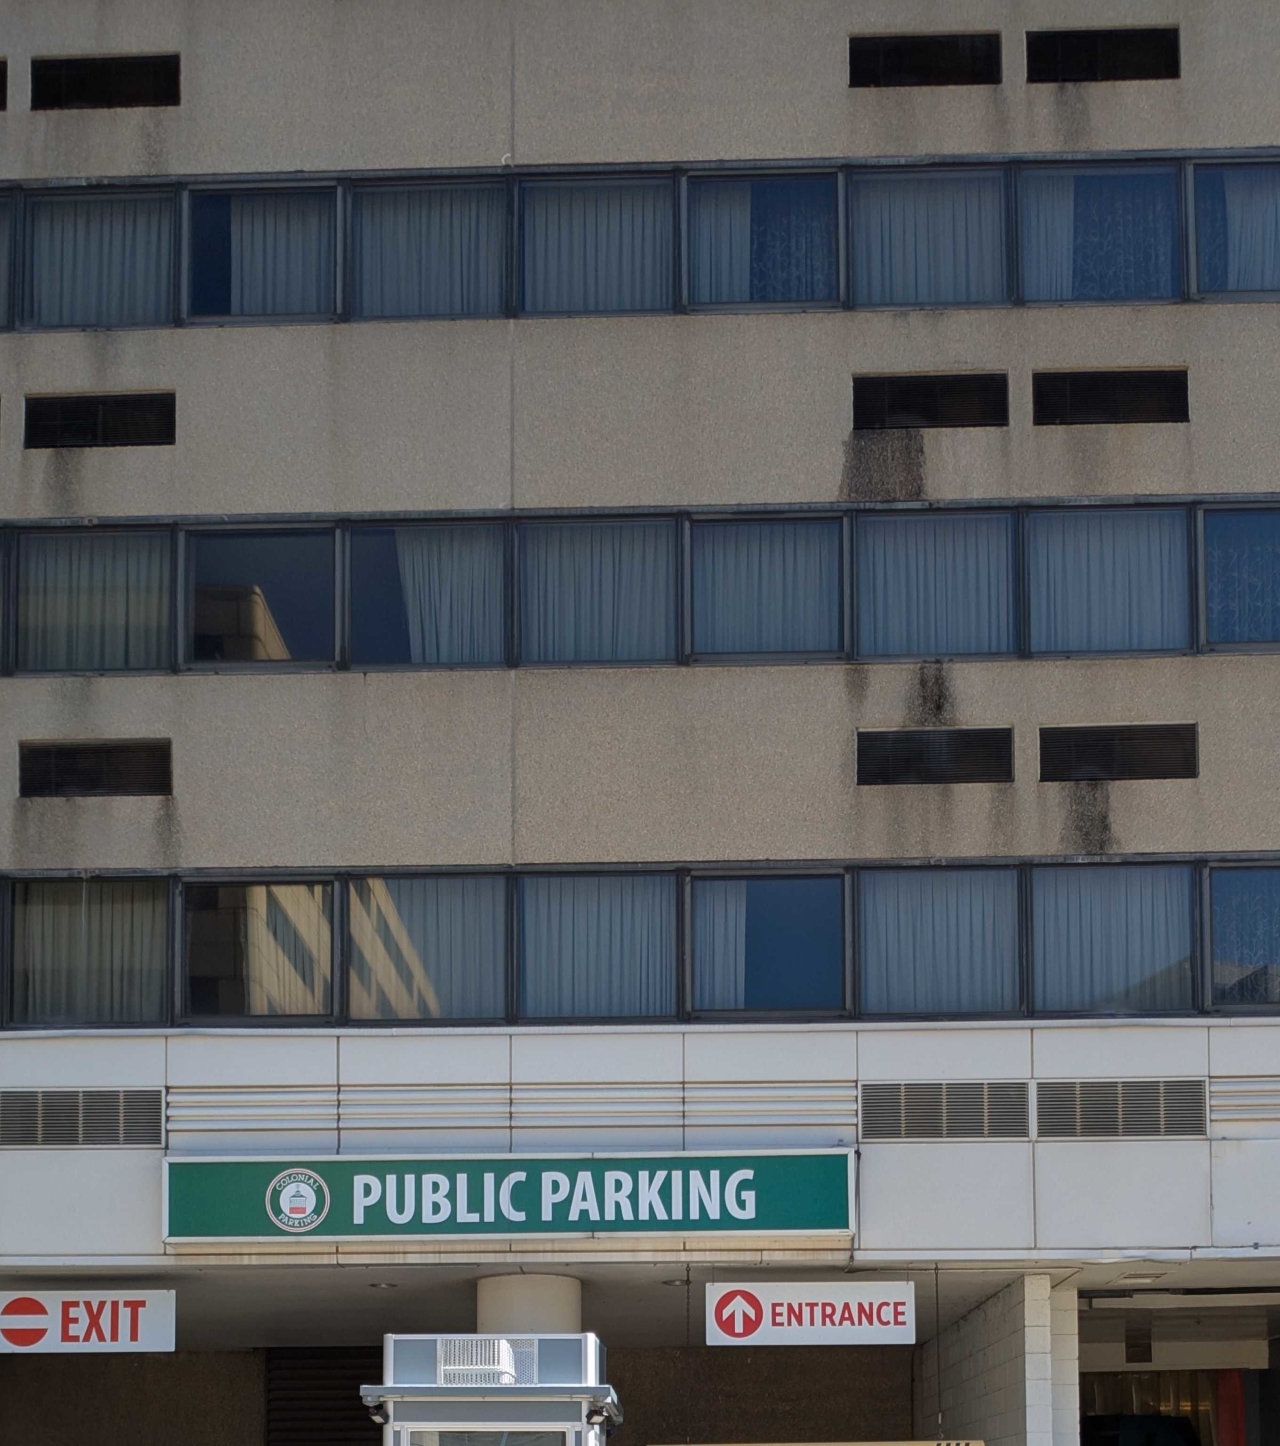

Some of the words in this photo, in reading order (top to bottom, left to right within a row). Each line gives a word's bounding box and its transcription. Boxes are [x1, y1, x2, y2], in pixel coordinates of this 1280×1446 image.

[276, 1174, 320, 1191] COLONIAL
[353, 1171, 527, 1225] PUBLIC
[541, 1169, 756, 1222] PARKING
[278, 1212, 318, 1227] PARKING
[60, 1299, 147, 1343] EXIT
[771, 1301, 907, 1327] ENTRANCE
